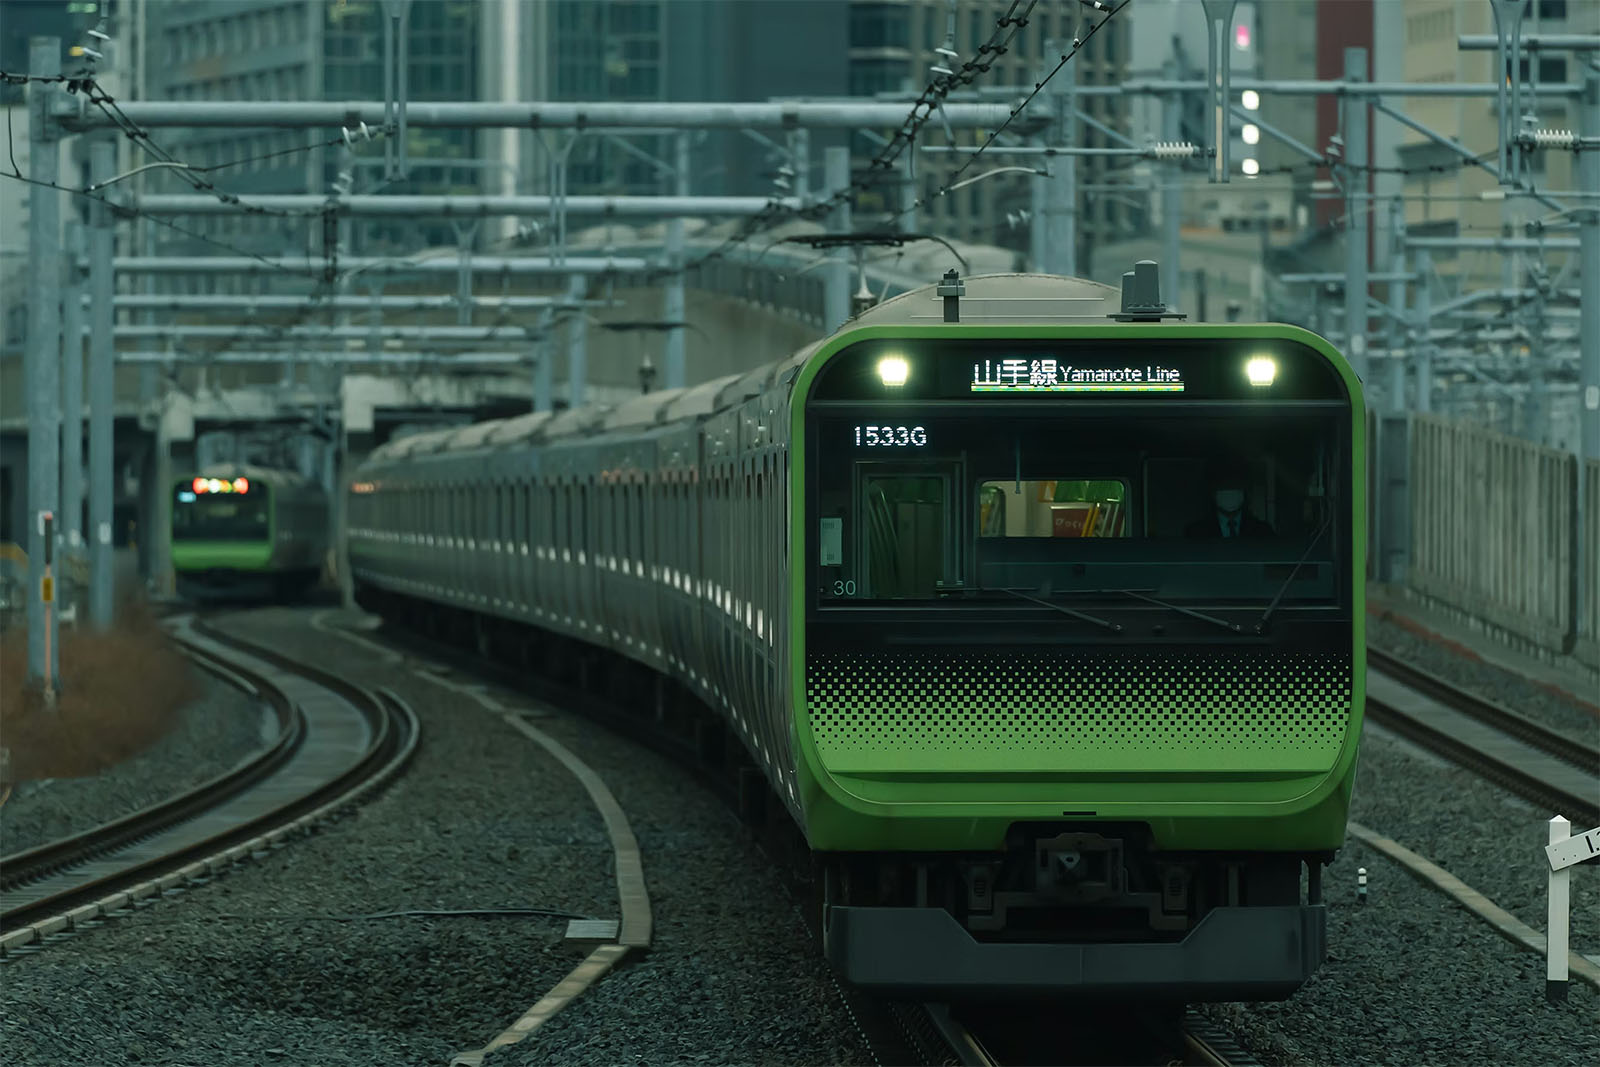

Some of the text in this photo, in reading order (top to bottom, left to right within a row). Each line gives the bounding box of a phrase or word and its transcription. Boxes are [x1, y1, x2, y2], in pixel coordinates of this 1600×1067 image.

[974, 359, 1180, 387] 山手線 Yamanote Line
[854, 426, 927, 446] 1533G
[833, 580, 856, 596] 30
